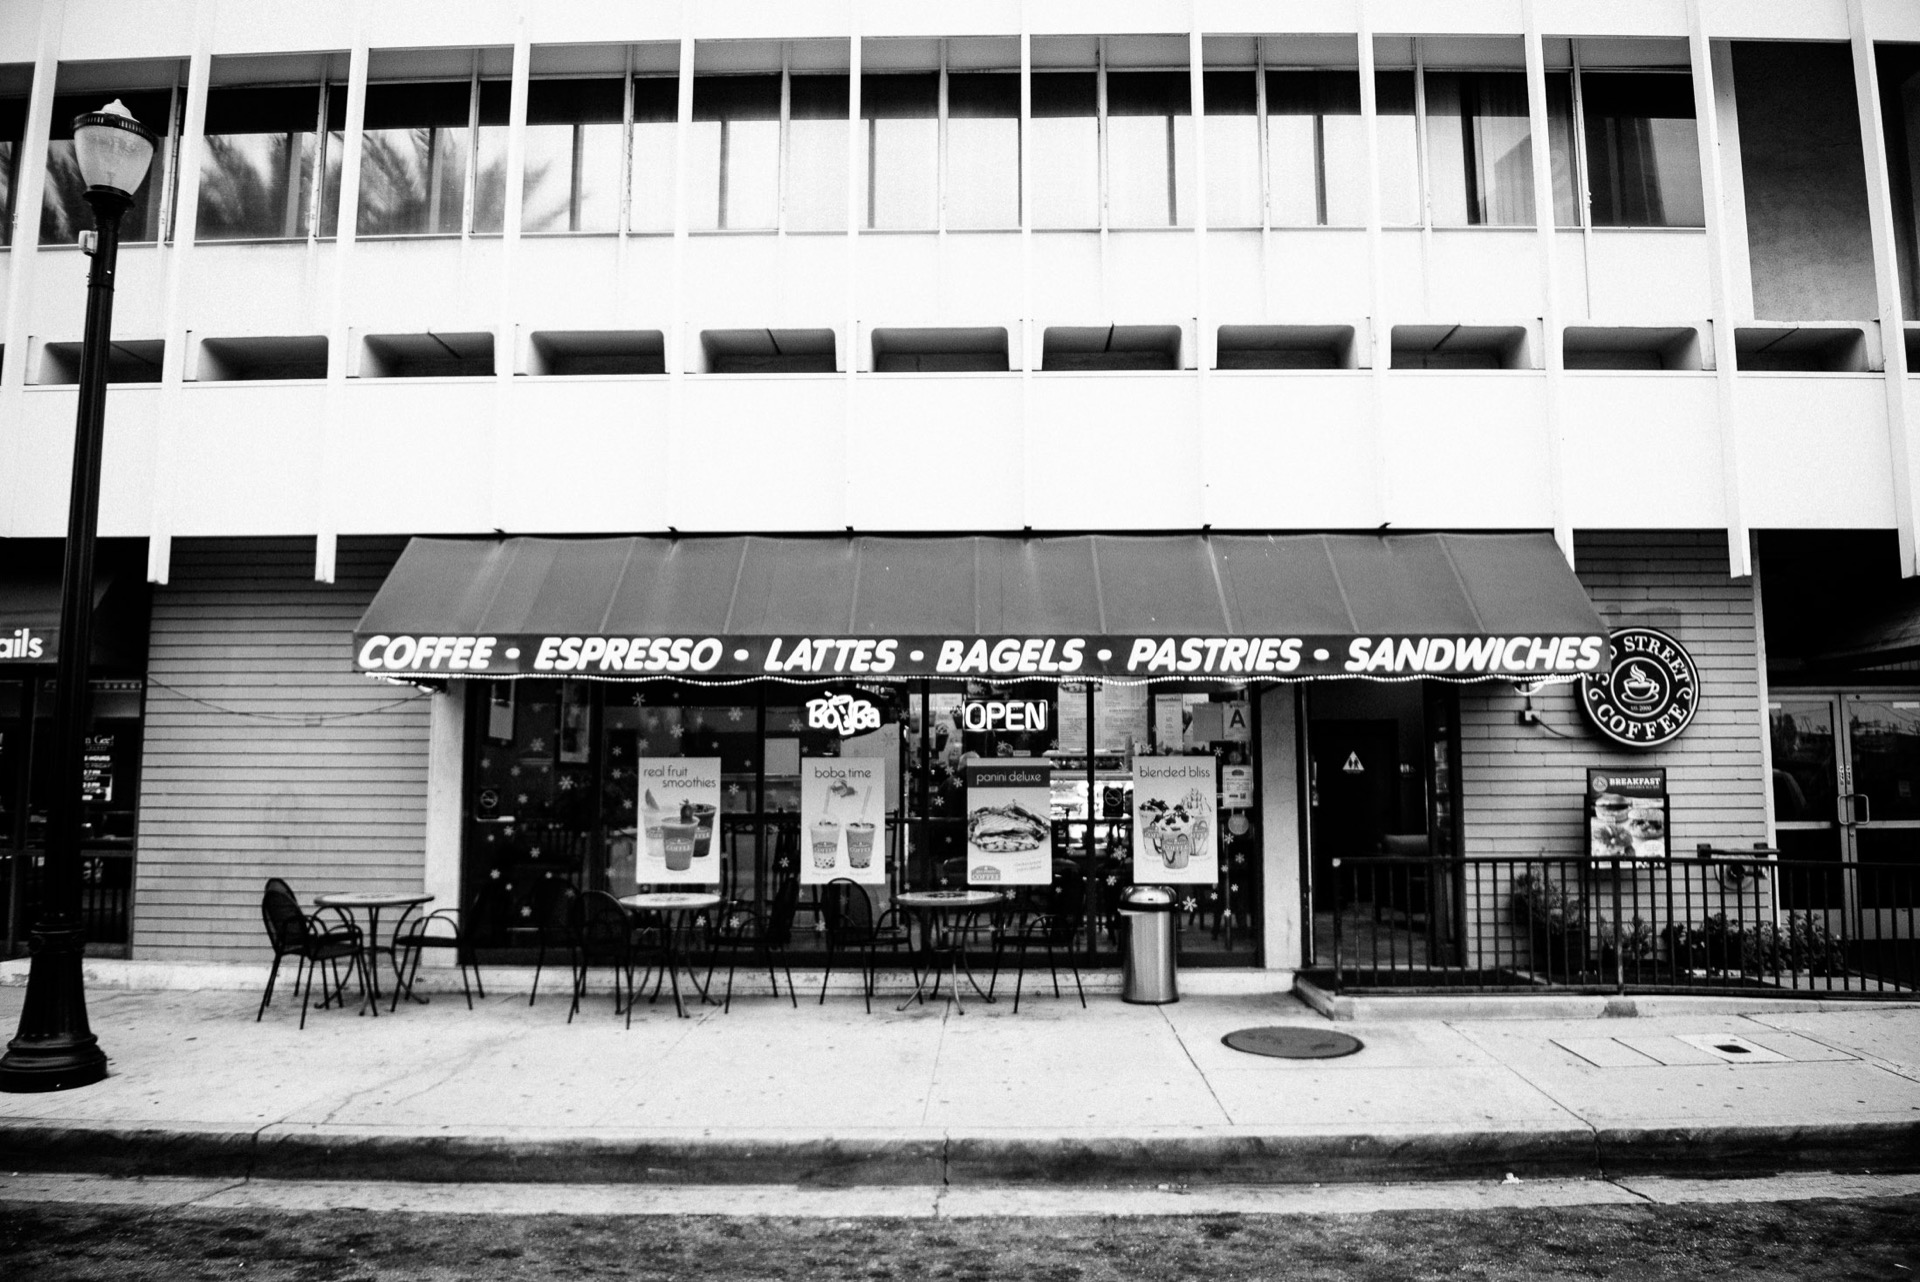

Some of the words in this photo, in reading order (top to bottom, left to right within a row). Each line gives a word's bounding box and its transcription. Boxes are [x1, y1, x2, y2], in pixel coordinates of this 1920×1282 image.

[358, 635, 497, 671] COFFEE
[534, 637, 723, 672] ESPRESSO
[764, 638, 898, 672] LATTES
[936, 638, 1085, 673] BAGELS
[1127, 638, 1303, 672] PASTRIES
[1344, 636, 1603, 673] SANDWICHES
[1623, 635, 1690, 682] STREET
[965, 702, 1046, 730] OPEN
[1230, 708, 1246, 729] A
[1597, 703, 1688, 740] COFFEE
[643, 765, 665, 777] real
[667, 765, 688, 777] fruit
[814, 766, 846, 779] boba
[848, 766, 872, 778] time
[976, 771, 1007, 786] panini
[1009, 770, 1042, 782] deluxe
[1139, 766, 1186, 778] blended
[1188, 766, 1211, 778] bliss
[662, 776, 717, 788] smoothies
[1609, 777, 1661, 786] BREAKFAST
